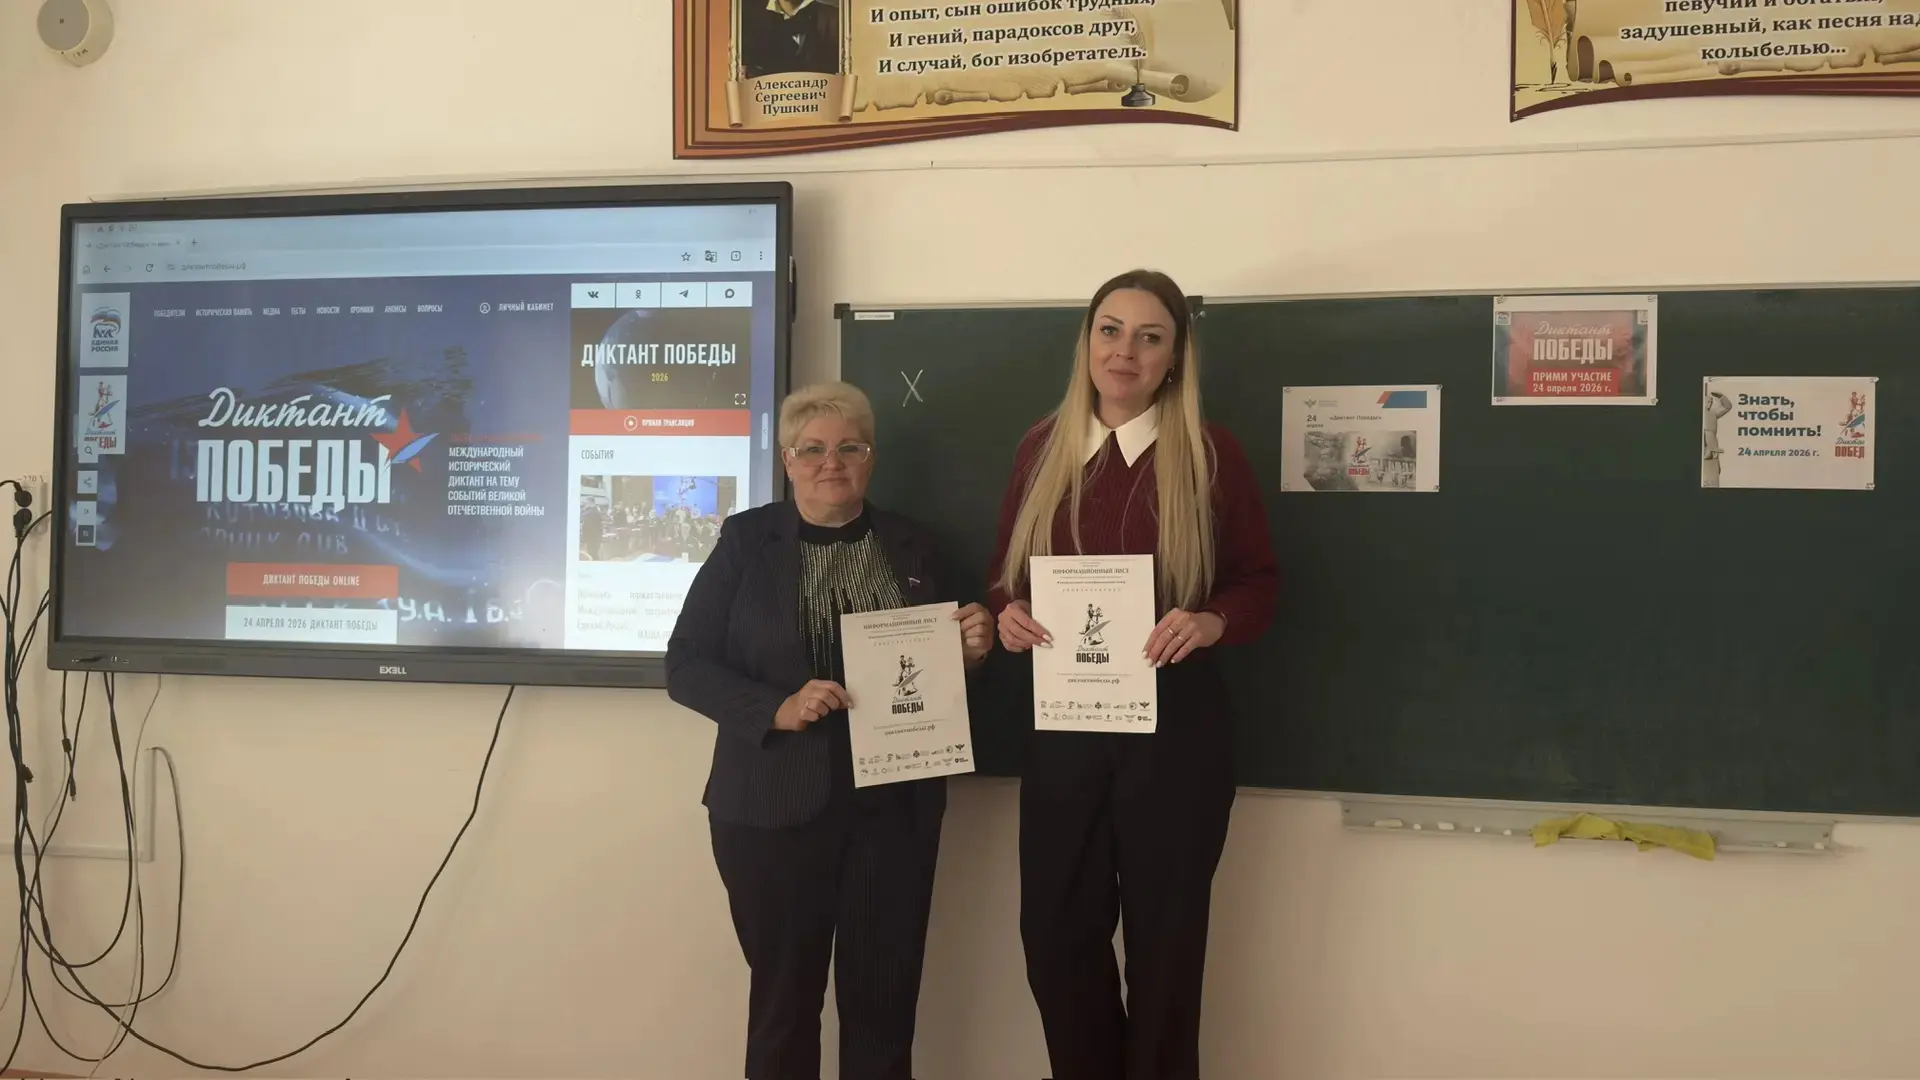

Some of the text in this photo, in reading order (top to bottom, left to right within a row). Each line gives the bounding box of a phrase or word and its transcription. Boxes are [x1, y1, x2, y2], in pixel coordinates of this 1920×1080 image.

[871, 9, 884, 23] И
[889, 8, 940, 22] опыт,
[944, 5, 981, 18] сын
[986, 0, 1062, 14] ошибок
[889, 19, 1137, 48] И гений, парадоксов друг,
[1621, 17, 1767, 40] задушевный,
[1773, 18, 1812, 31] как
[1818, 15, 1882, 29] песня
[1701, 41, 1846, 60] колыбелью...
[879, 45, 1147, 75] И случай, бог изобретатель.
[754, 79, 828, 90] Александр
[755, 91, 827, 104] Сергеевич
[763, 104, 819, 116] Пушкин
[195, 308, 232, 317] ИСТОРИЧЕСКАЯ
[316, 306, 340, 315] НОВОСТИ
[384, 304, 407, 313] АНОНСЫ
[417, 304, 443, 313] ВОПРОСЫ
[498, 301, 554, 311] ЛИЧНЫЙ КАБИНЕТ
[1533, 320, 1613, 335] Диктант
[581, 343, 736, 367] ДИКТАНТ ПОБЕДЫ
[1533, 338, 1613, 364] ПОБЕДЫ
[651, 372, 669, 382] 2026
[1533, 371, 1612, 382] ПРИМИ УЧАСТИЕ
[1533, 383, 1611, 395] 24 апреля 2026 г.
[1738, 393, 1795, 408] Знать,
[199, 387, 393, 428] Диктант
[1306, 414, 1317, 422] 24
[1737, 408, 1794, 421] чтобы
[1737, 425, 1822, 437] помнить!
[448, 445, 524, 458] МЕЖДУНАРОДНЫЙ
[581, 449, 614, 460] СОБЫТИЯ
[1737, 447, 1751, 457] 24
[1753, 449, 1786, 457] АПРЕЛЯ
[1788, 449, 1810, 457] 2026
[448, 459, 511, 472] ИСТОРИЧЕСКИЙ
[196, 439, 392, 516] ПОБЕДЫ
[448, 475, 520, 488] ДИКТАНТ НА ТЕМУ
[448, 489, 526, 502] СОБЫТИЙ ВЕЛИКОЙ
[447, 504, 545, 516] ОТЕЧЕСТВЕННОЙ ВОЙНЫ
[1052, 567, 1113, 575] ИНФОРМАЦИОННЫЙ
[262, 574, 360, 587] ДИКТАНТ ПОБЕДЫ ONLINE
[243, 617, 378, 631] 24 АПРЕЛЯ 2026 ДИКТАНТ ПОБЕДЫ
[863, 619, 921, 629] ИНФОРМАЦИОННЫЙ
[1076, 652, 1109, 664] ПОБЕДЫ
[892, 701, 924, 714] ПОБЕДЫ
